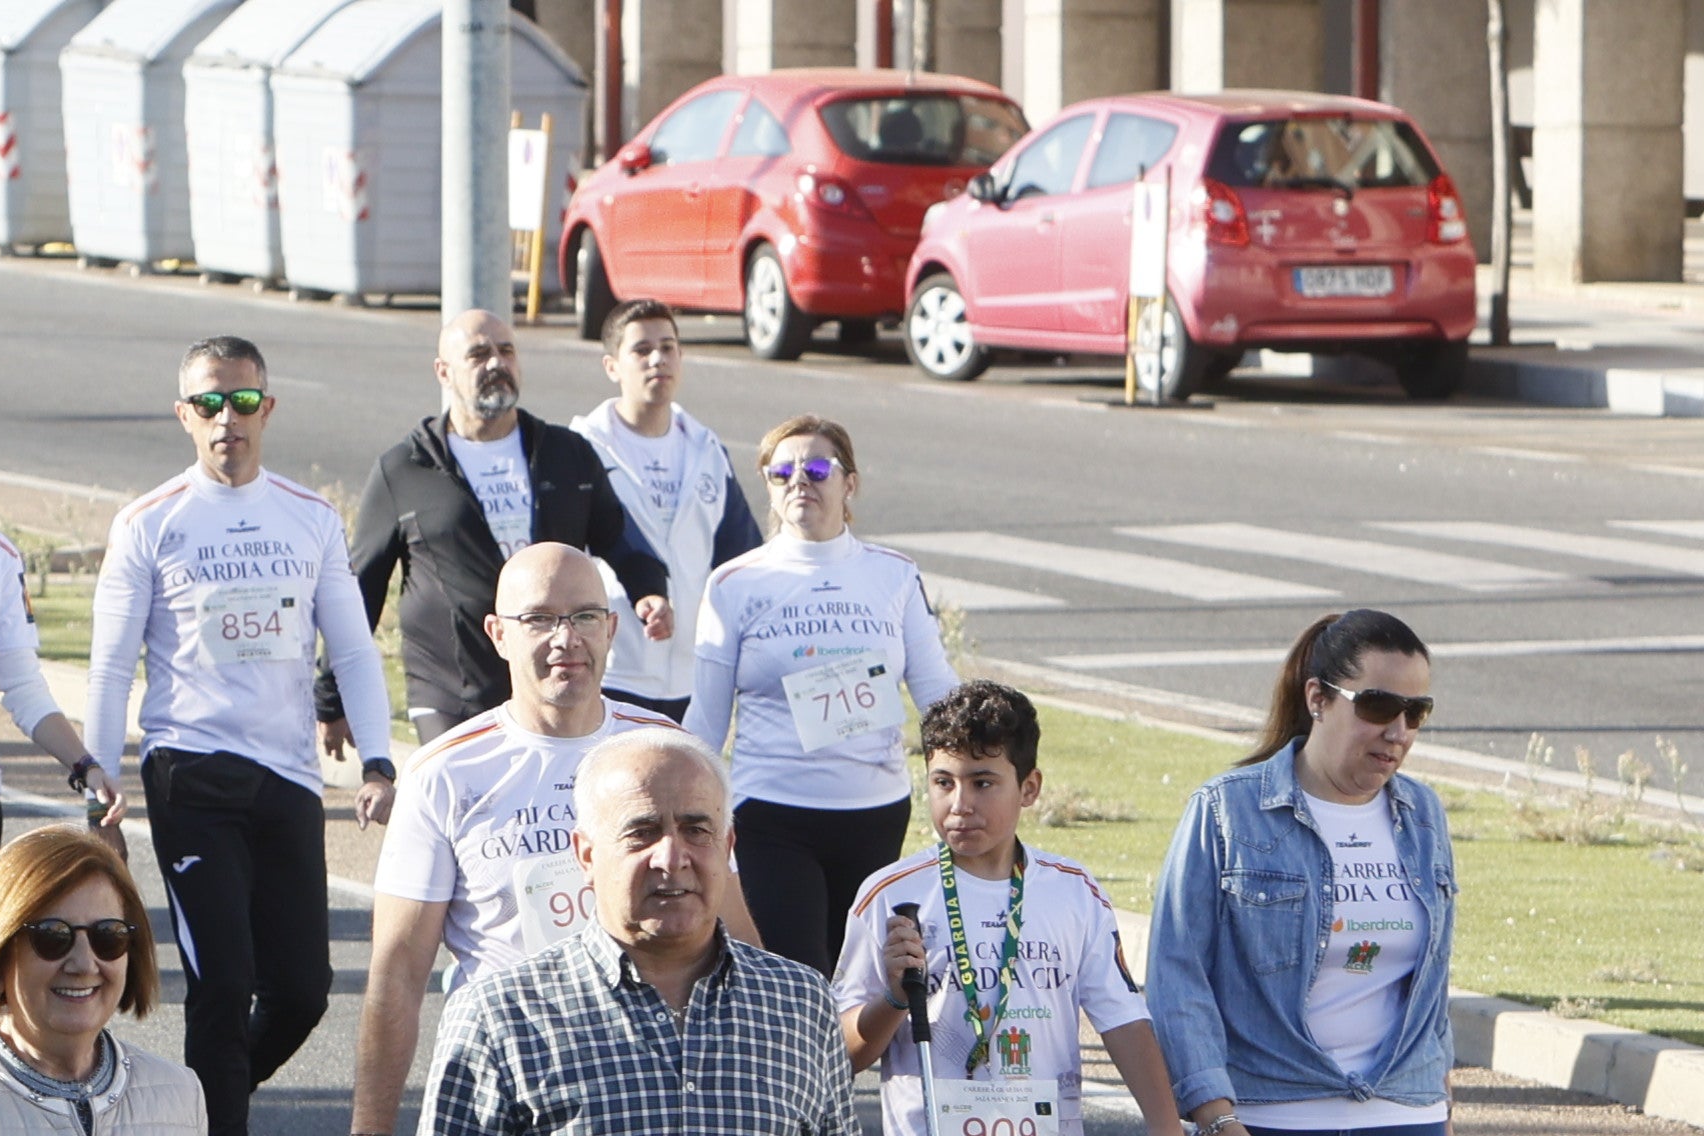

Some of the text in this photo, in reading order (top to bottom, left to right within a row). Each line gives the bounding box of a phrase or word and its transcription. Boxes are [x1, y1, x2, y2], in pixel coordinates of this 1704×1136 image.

[198, 540, 295, 561] III CARRERA
[171, 560, 264, 587] GVARDIA
[782, 601, 873, 618] III CARRERA
[221, 610, 283, 641] 854
[756, 619, 844, 640] GVARDIA
[812, 681, 876, 722] 716
[516, 806, 539, 826] III
[481, 828, 572, 860] GVARD
[548, 885, 597, 928] 90
[1347, 918, 1414, 931] Iberdrola
[946, 896, 974, 985] GUARDIA
[975, 940, 1063, 963] CARERA
[1002, 1004, 1052, 1020] berdrola
[999, 1066, 1033, 1076] ALCER
